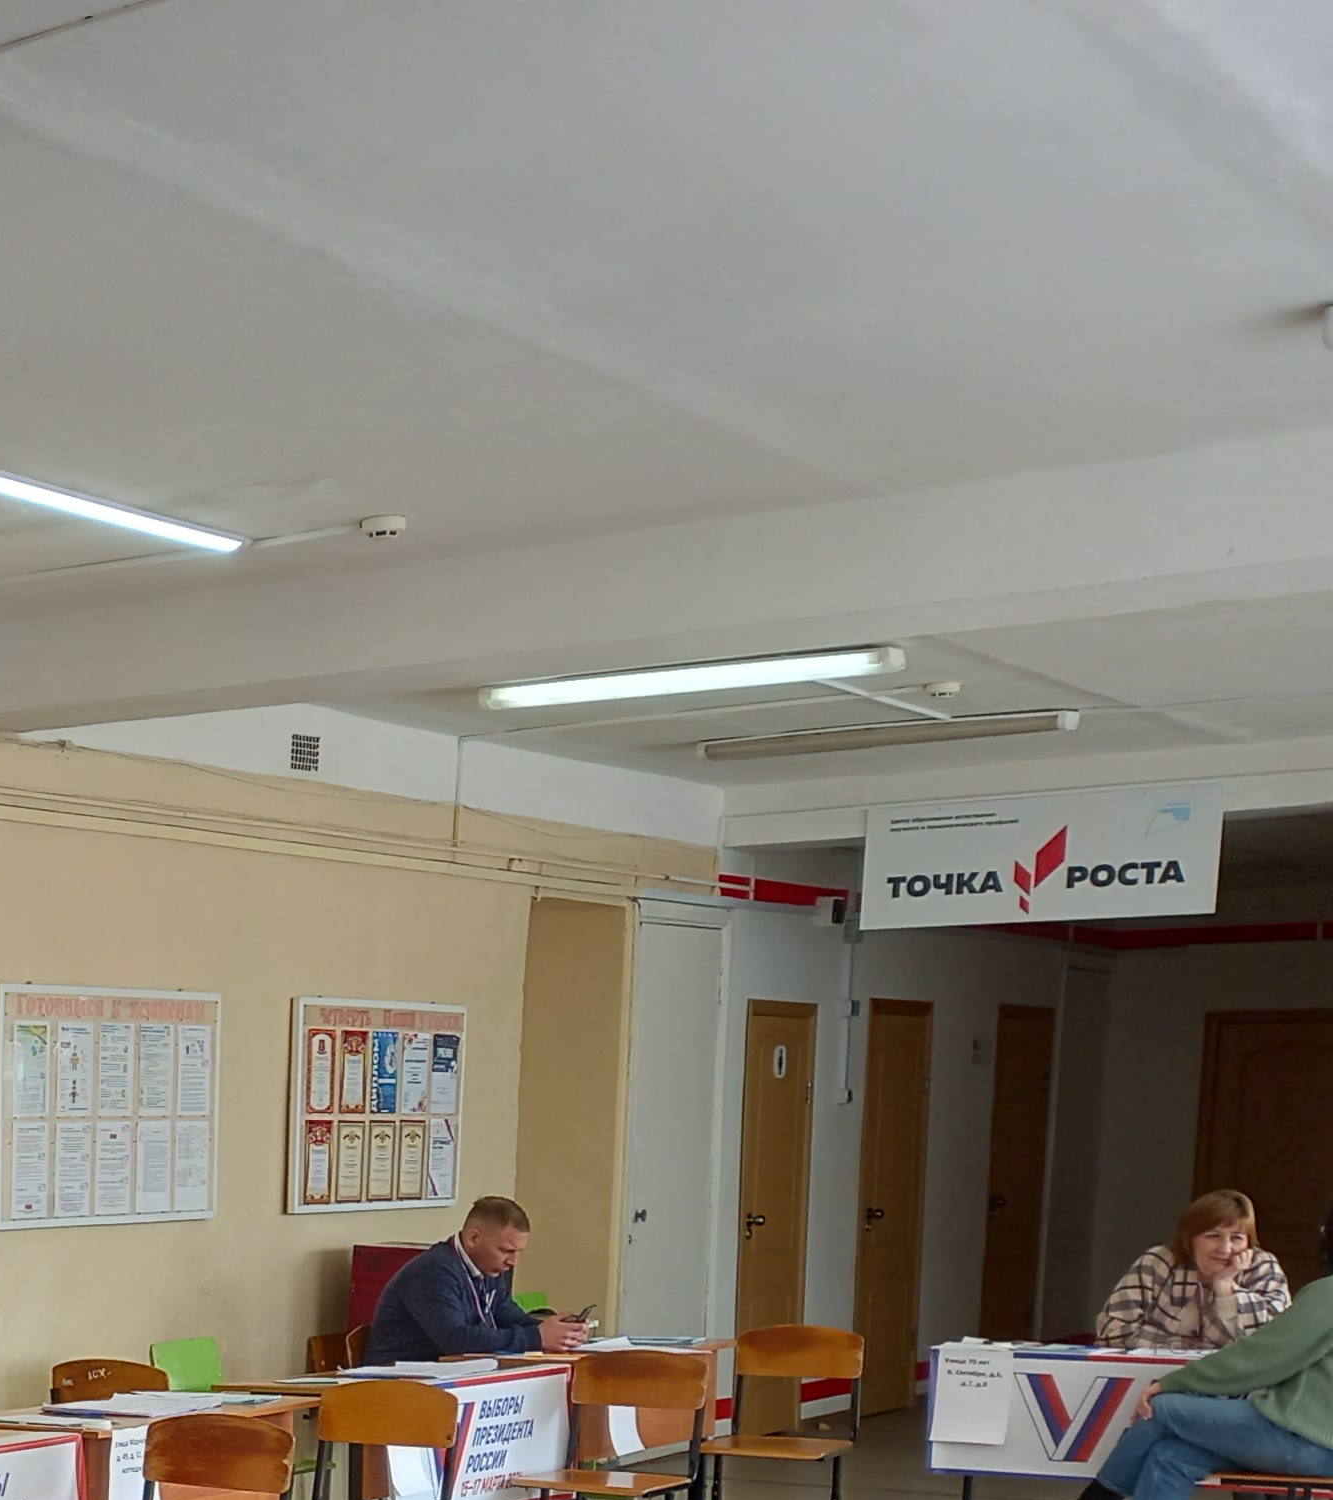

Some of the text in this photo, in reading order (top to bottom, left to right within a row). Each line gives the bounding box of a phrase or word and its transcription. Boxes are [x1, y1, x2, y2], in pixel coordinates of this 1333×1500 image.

[886, 860, 1185, 898] ТОЧКА РОСТА
[479, 1395, 524, 1419] ВЫБОРЫ
[472, 1419, 534, 1447] ПРЕЗИДЕНТА
[465, 1450, 507, 1474] РОССИИ
[482, 1474, 506, 1494] МАРТА
